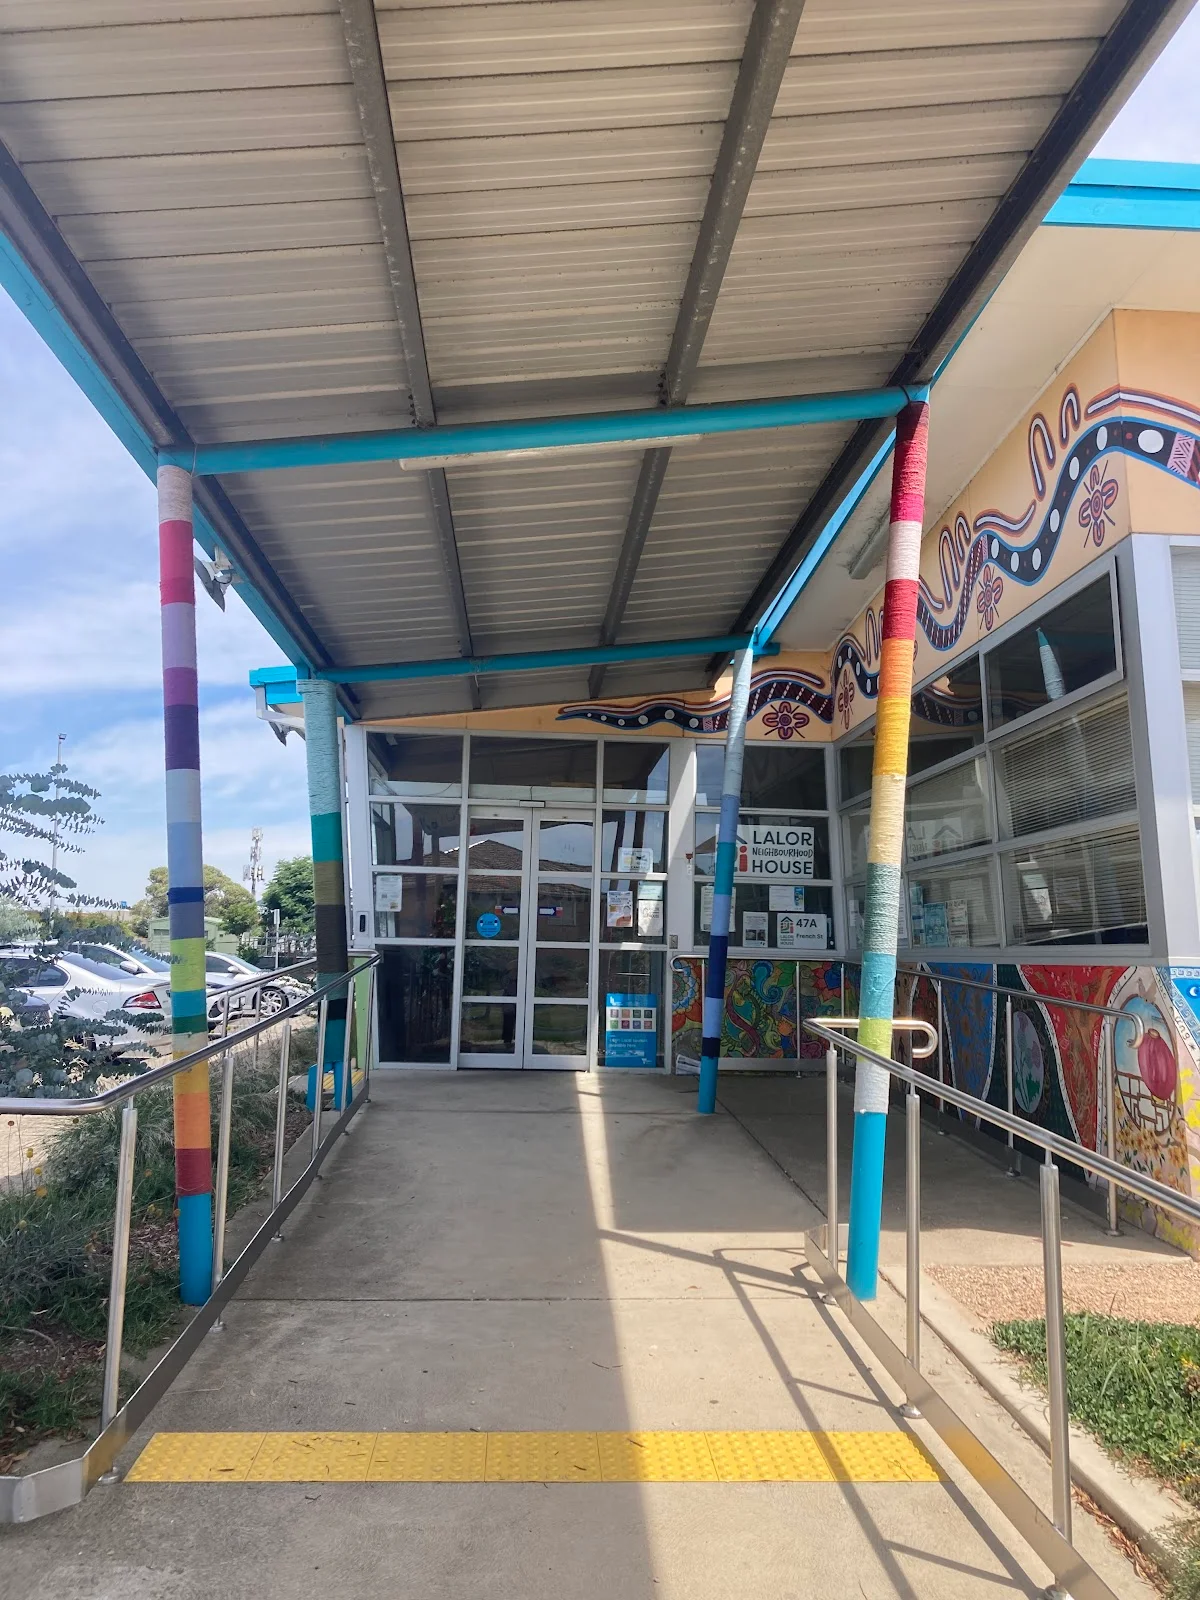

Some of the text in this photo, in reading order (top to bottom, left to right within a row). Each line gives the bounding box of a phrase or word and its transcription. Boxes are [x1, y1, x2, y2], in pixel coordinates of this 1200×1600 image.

[753, 830, 813, 846] LALOR
[752, 847, 814, 858] NEIGHBOURHOOD
[752, 859, 813, 875] HOUSE
[796, 918, 817, 928] 47A
